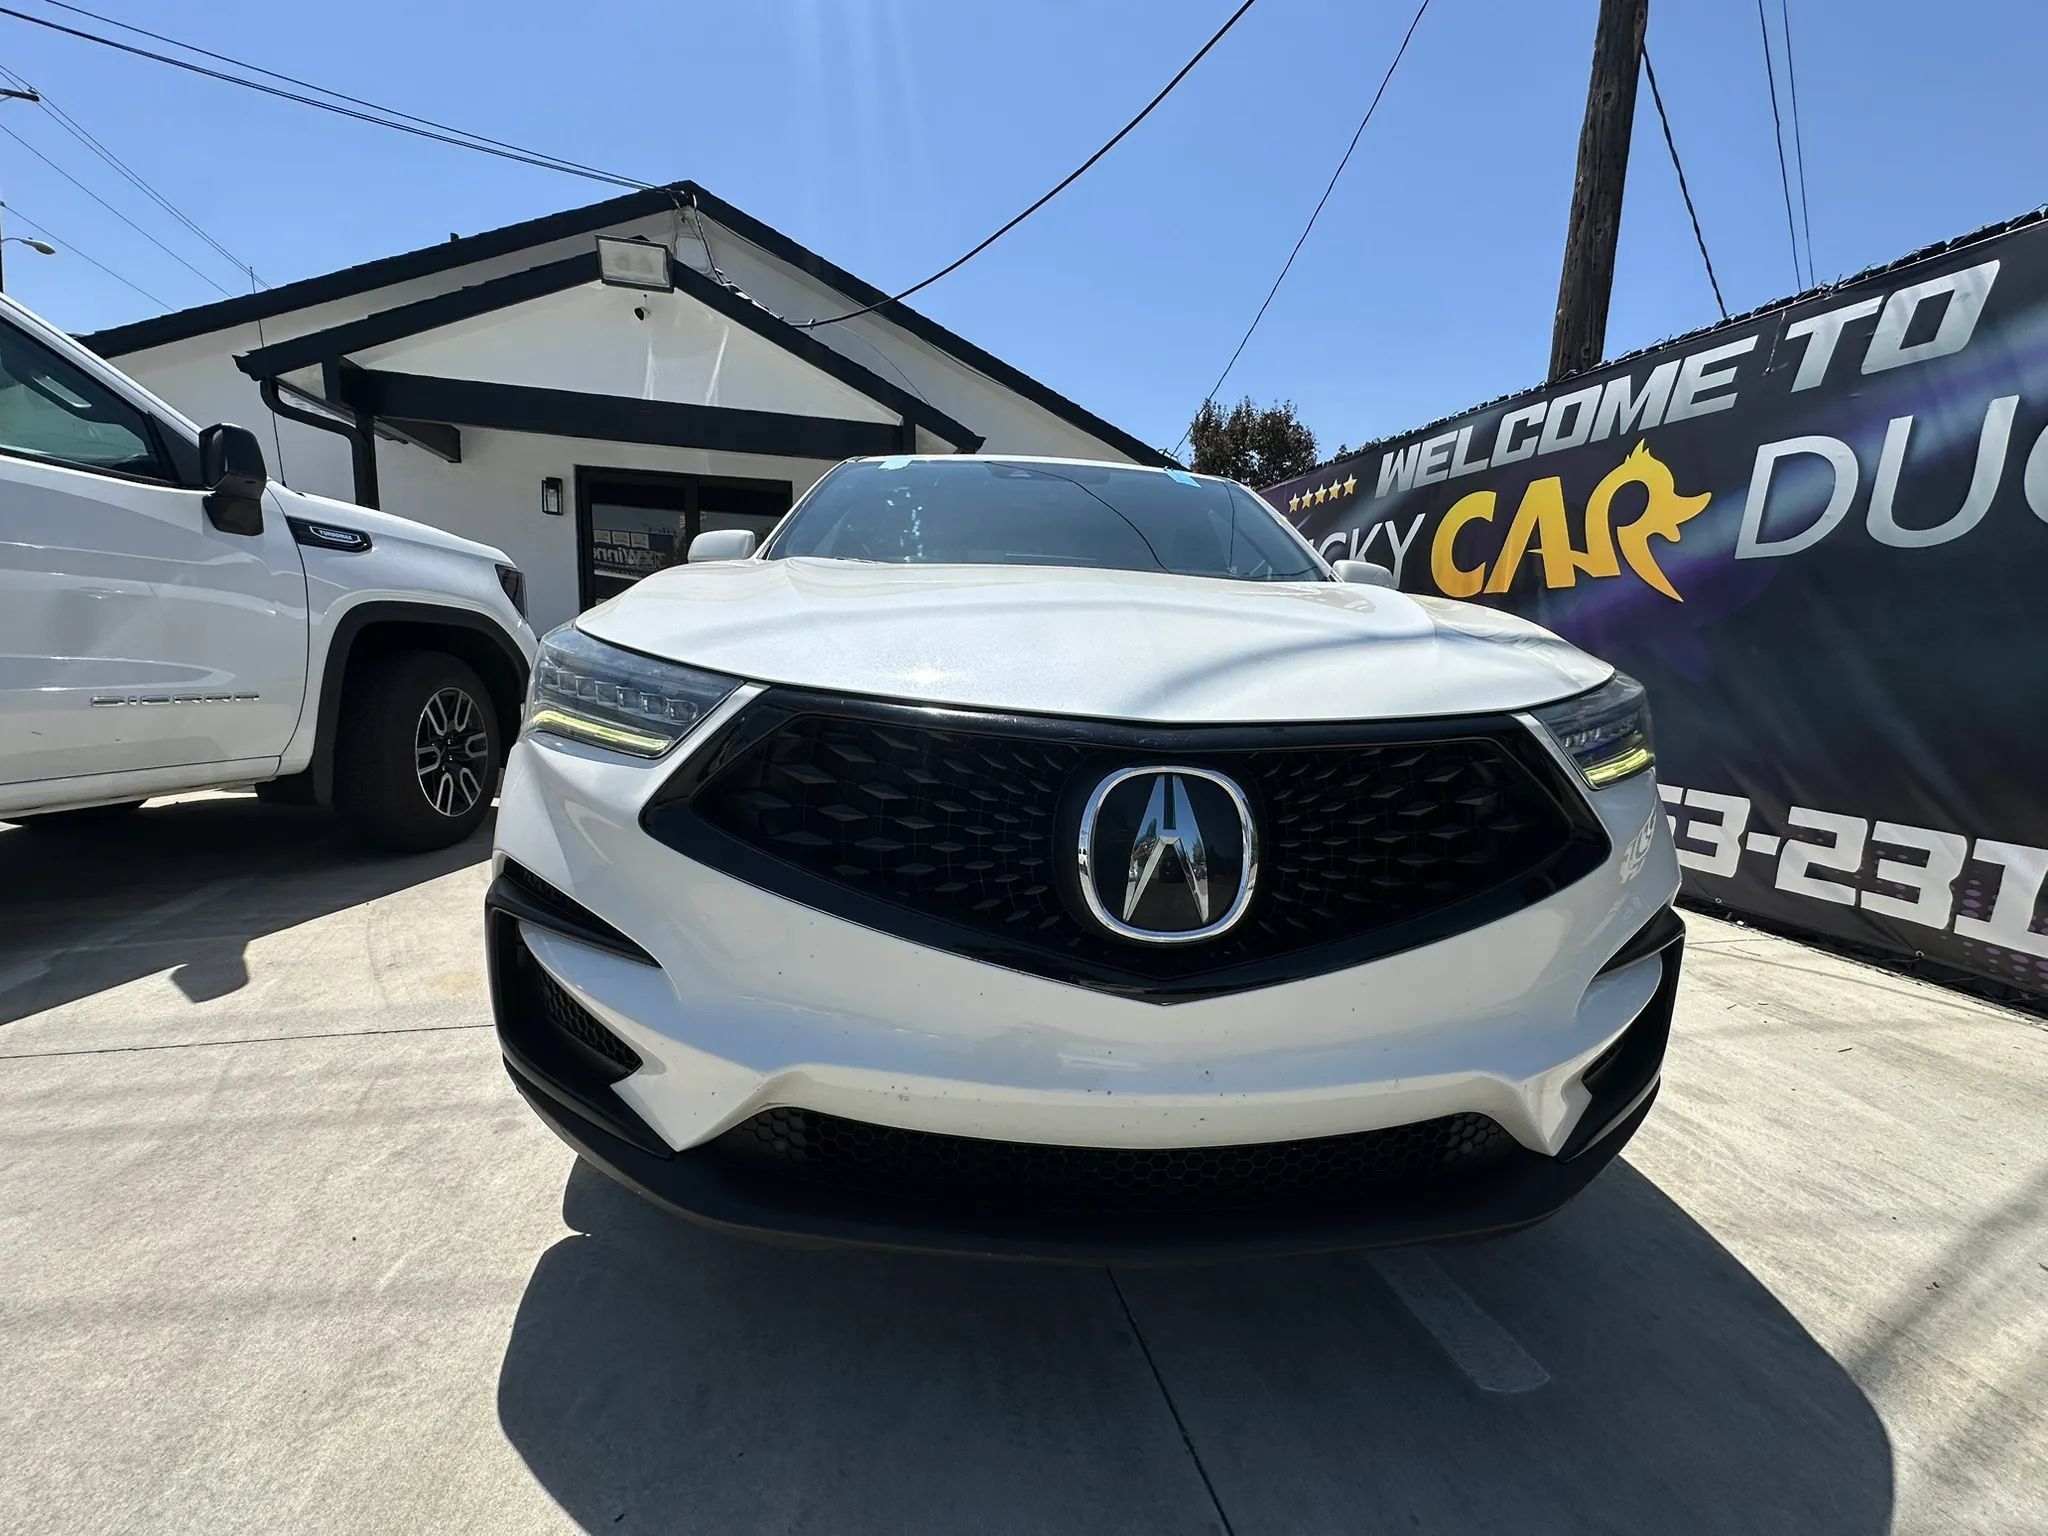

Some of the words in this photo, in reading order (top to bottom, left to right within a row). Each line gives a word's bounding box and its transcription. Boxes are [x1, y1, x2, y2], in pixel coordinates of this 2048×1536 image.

[1374, 336, 1758, 499] WELCOME
[1785, 260, 2000, 394] TO
[1308, 513, 1426, 590] CKY
[1430, 438, 1712, 602] CAR
